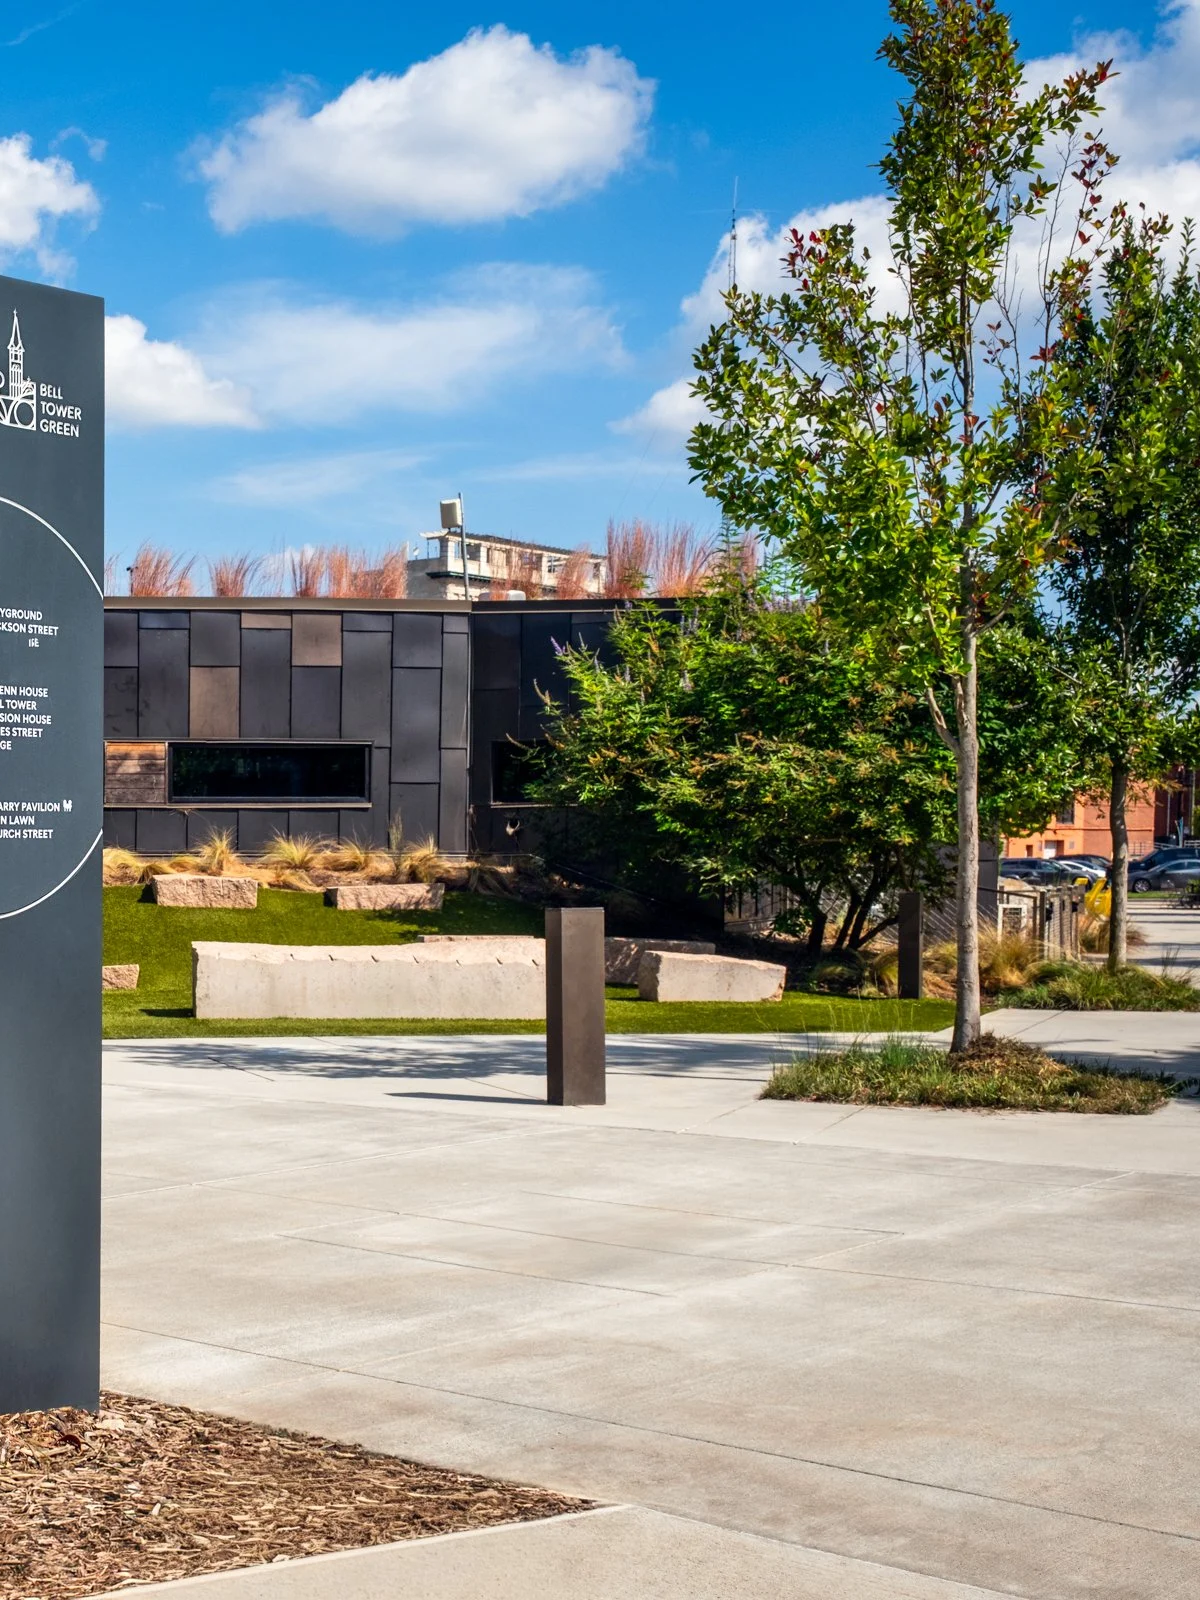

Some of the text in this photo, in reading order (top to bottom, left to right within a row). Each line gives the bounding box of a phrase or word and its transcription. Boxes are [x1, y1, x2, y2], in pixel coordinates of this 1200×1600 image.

[39, 383, 64, 400] BELL
[40, 401, 82, 421] TOWER
[39, 419, 80, 438] GREEN
[27, 623, 59, 636] STREET
[18, 686, 49, 698] HOUSE
[5, 699, 37, 711] TOWER
[22, 713, 52, 725] HOUSE
[11, 727, 44, 738] STREET
[21, 801, 61, 813] PAVILION
[8, 815, 35, 826] LAWN
[22, 828, 54, 839] STREET
